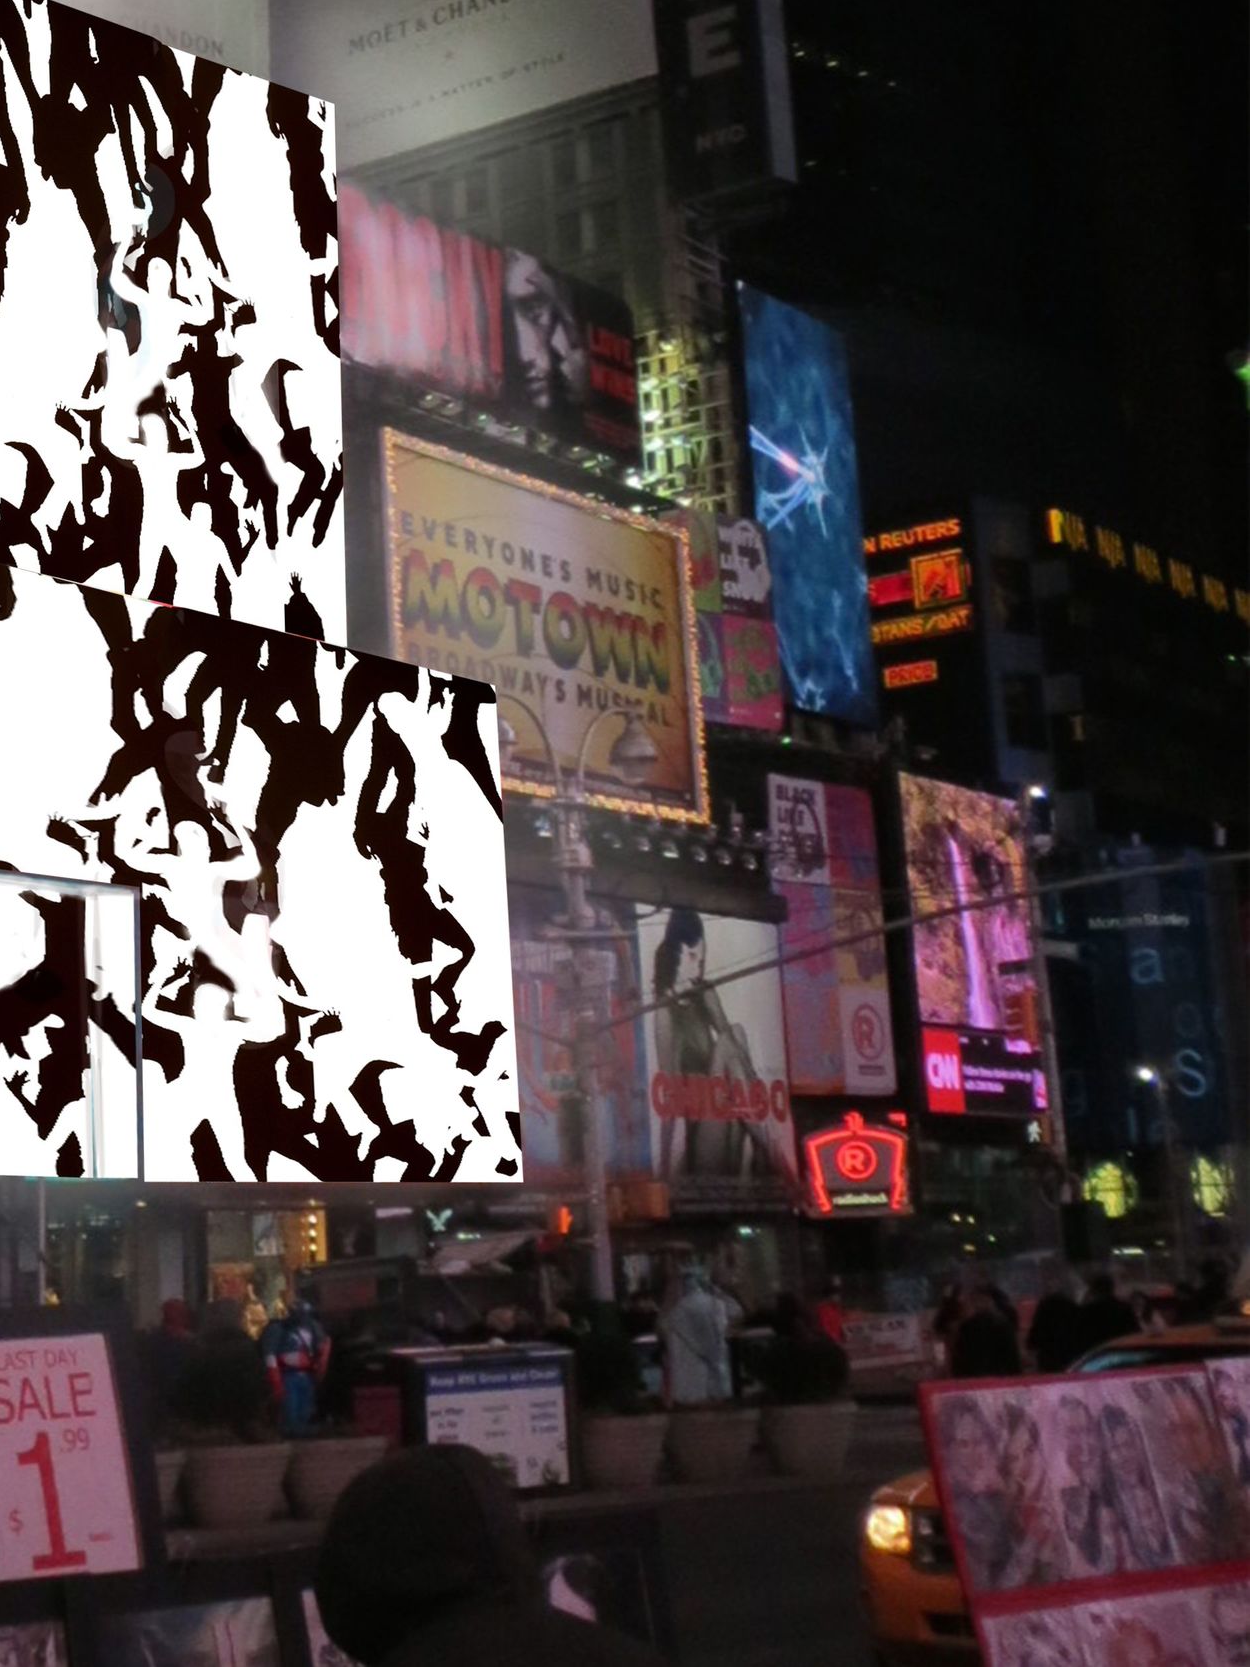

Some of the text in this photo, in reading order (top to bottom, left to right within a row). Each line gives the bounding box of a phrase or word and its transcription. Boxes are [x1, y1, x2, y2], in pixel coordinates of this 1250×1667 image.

[878, 517, 962, 552] REUTERS
[586, 566, 666, 611] MUSIC
[403, 548, 673, 695] MOTOWN
[577, 684, 672, 727] MUSAL
[651, 1069, 787, 1124] CHICAGO
[43, 1348, 79, 1368] DAY
[16, 1428, 91, 1571] 1 .99
[7, 1507, 25, 1537] $
